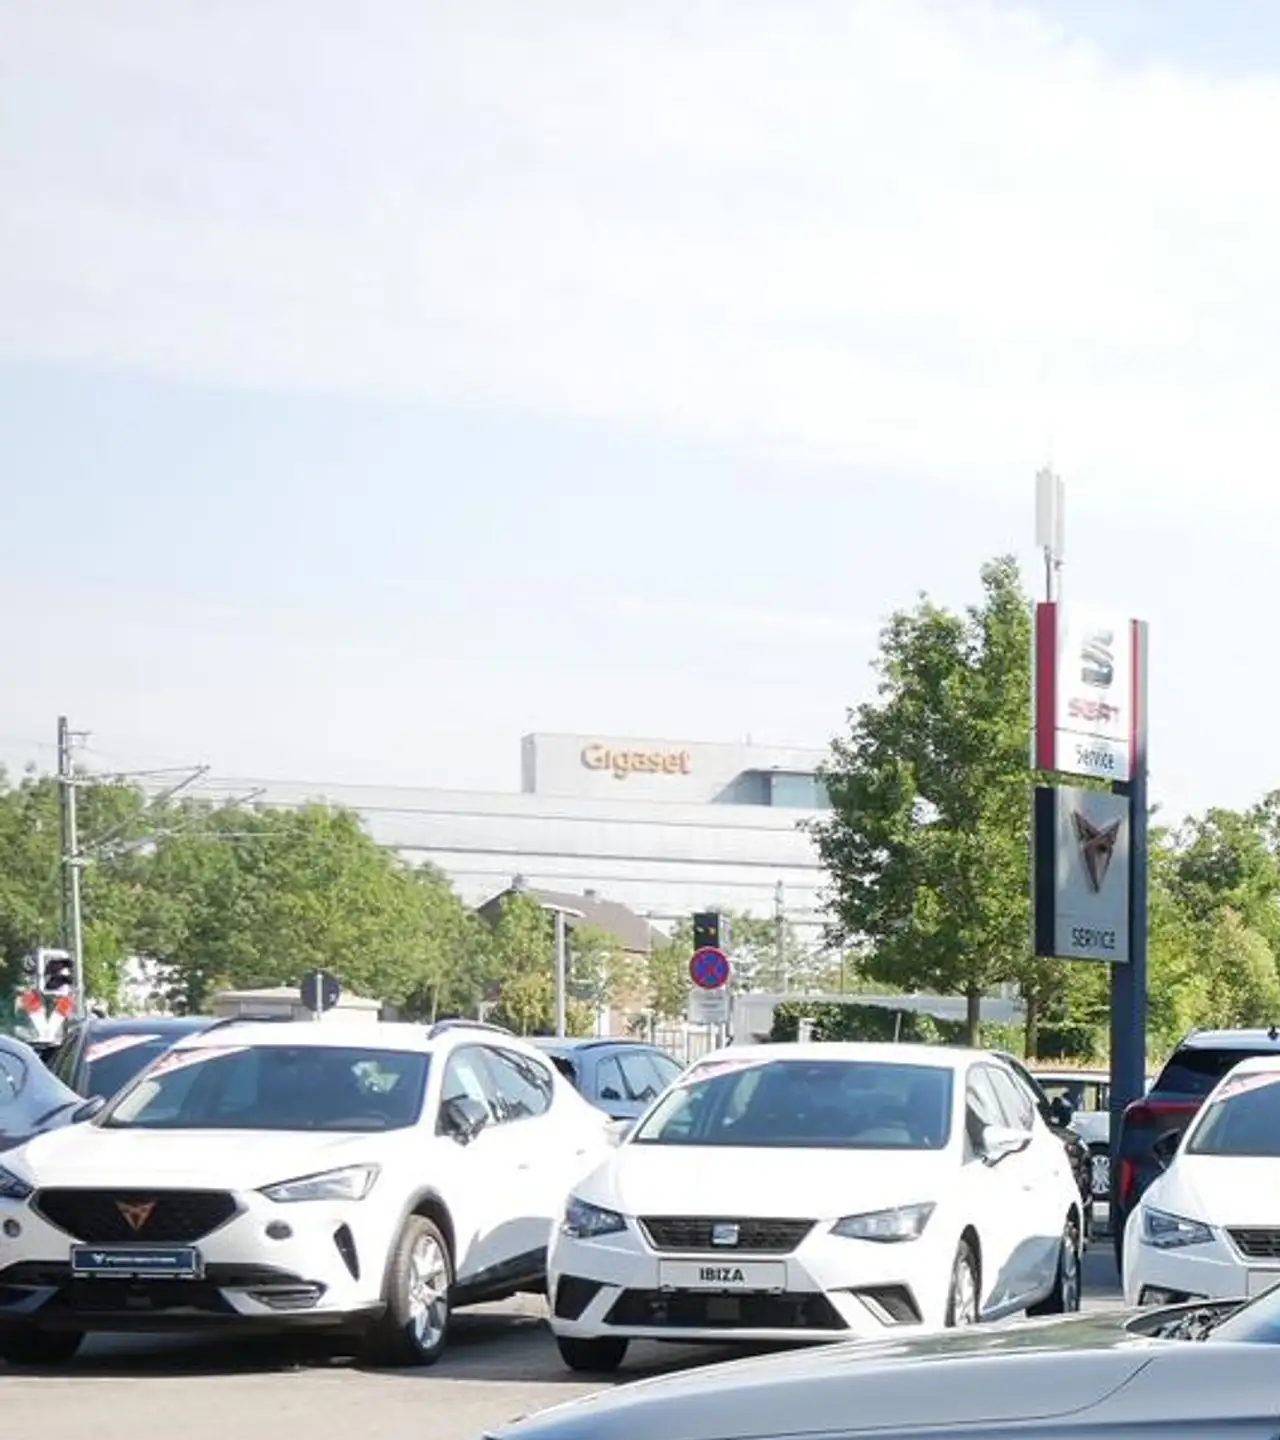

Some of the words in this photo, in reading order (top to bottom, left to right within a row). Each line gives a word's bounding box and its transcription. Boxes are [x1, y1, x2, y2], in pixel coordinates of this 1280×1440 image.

[580, 743, 692, 780] Gigaset
[1075, 743, 1115, 771] Service
[1072, 927, 1115, 950] SERVICE
[700, 1268, 744, 1282] IBIZA
